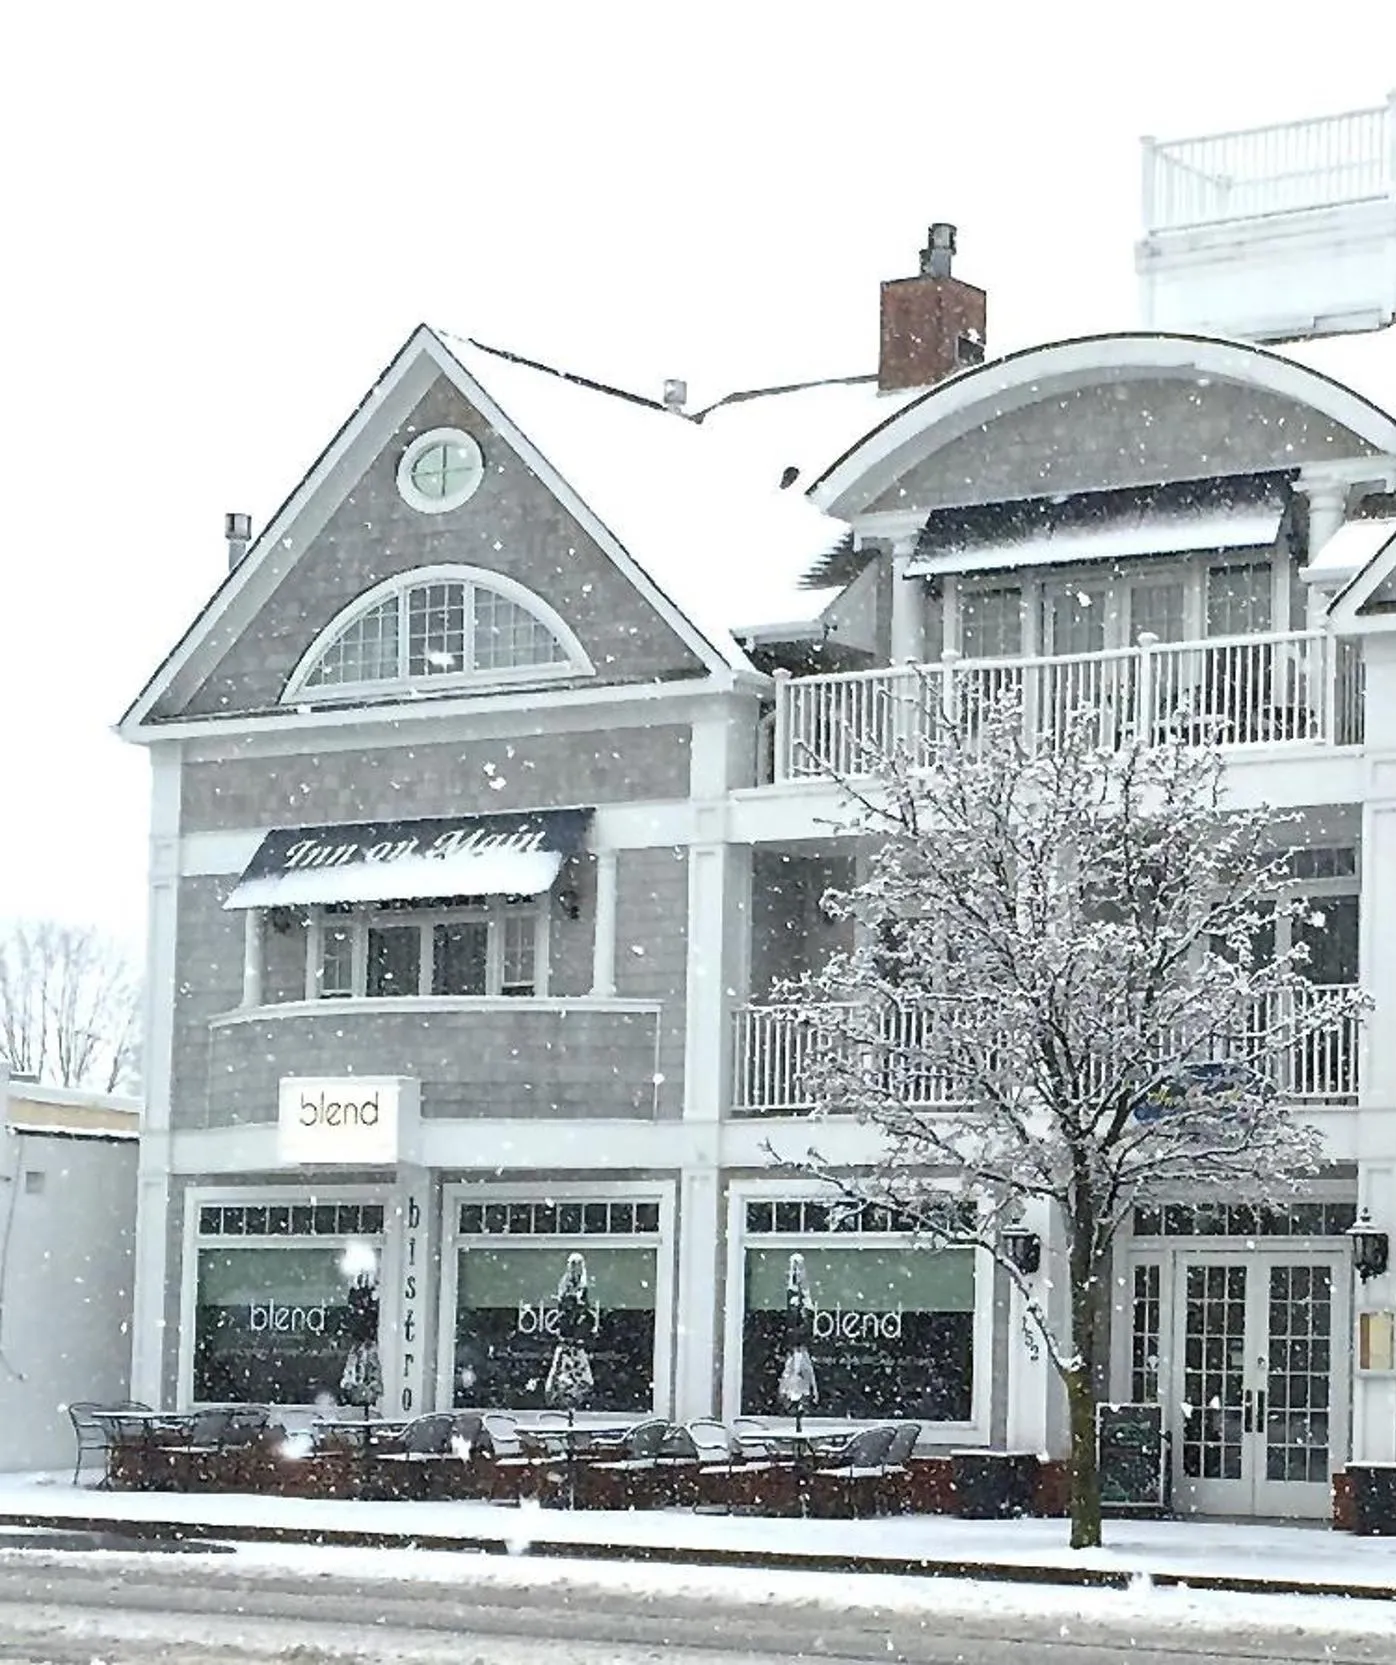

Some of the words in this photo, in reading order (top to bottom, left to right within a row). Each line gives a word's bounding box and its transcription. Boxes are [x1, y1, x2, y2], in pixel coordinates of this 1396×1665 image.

[283, 840, 358, 867] Inn
[364, 836, 419, 860] on
[430, 824, 546, 857] Main
[299, 1090, 379, 1126] blend
[250, 1298, 326, 1331] blend
[401, 1196, 420, 1411] bistro
[813, 1300, 902, 1338] blend
